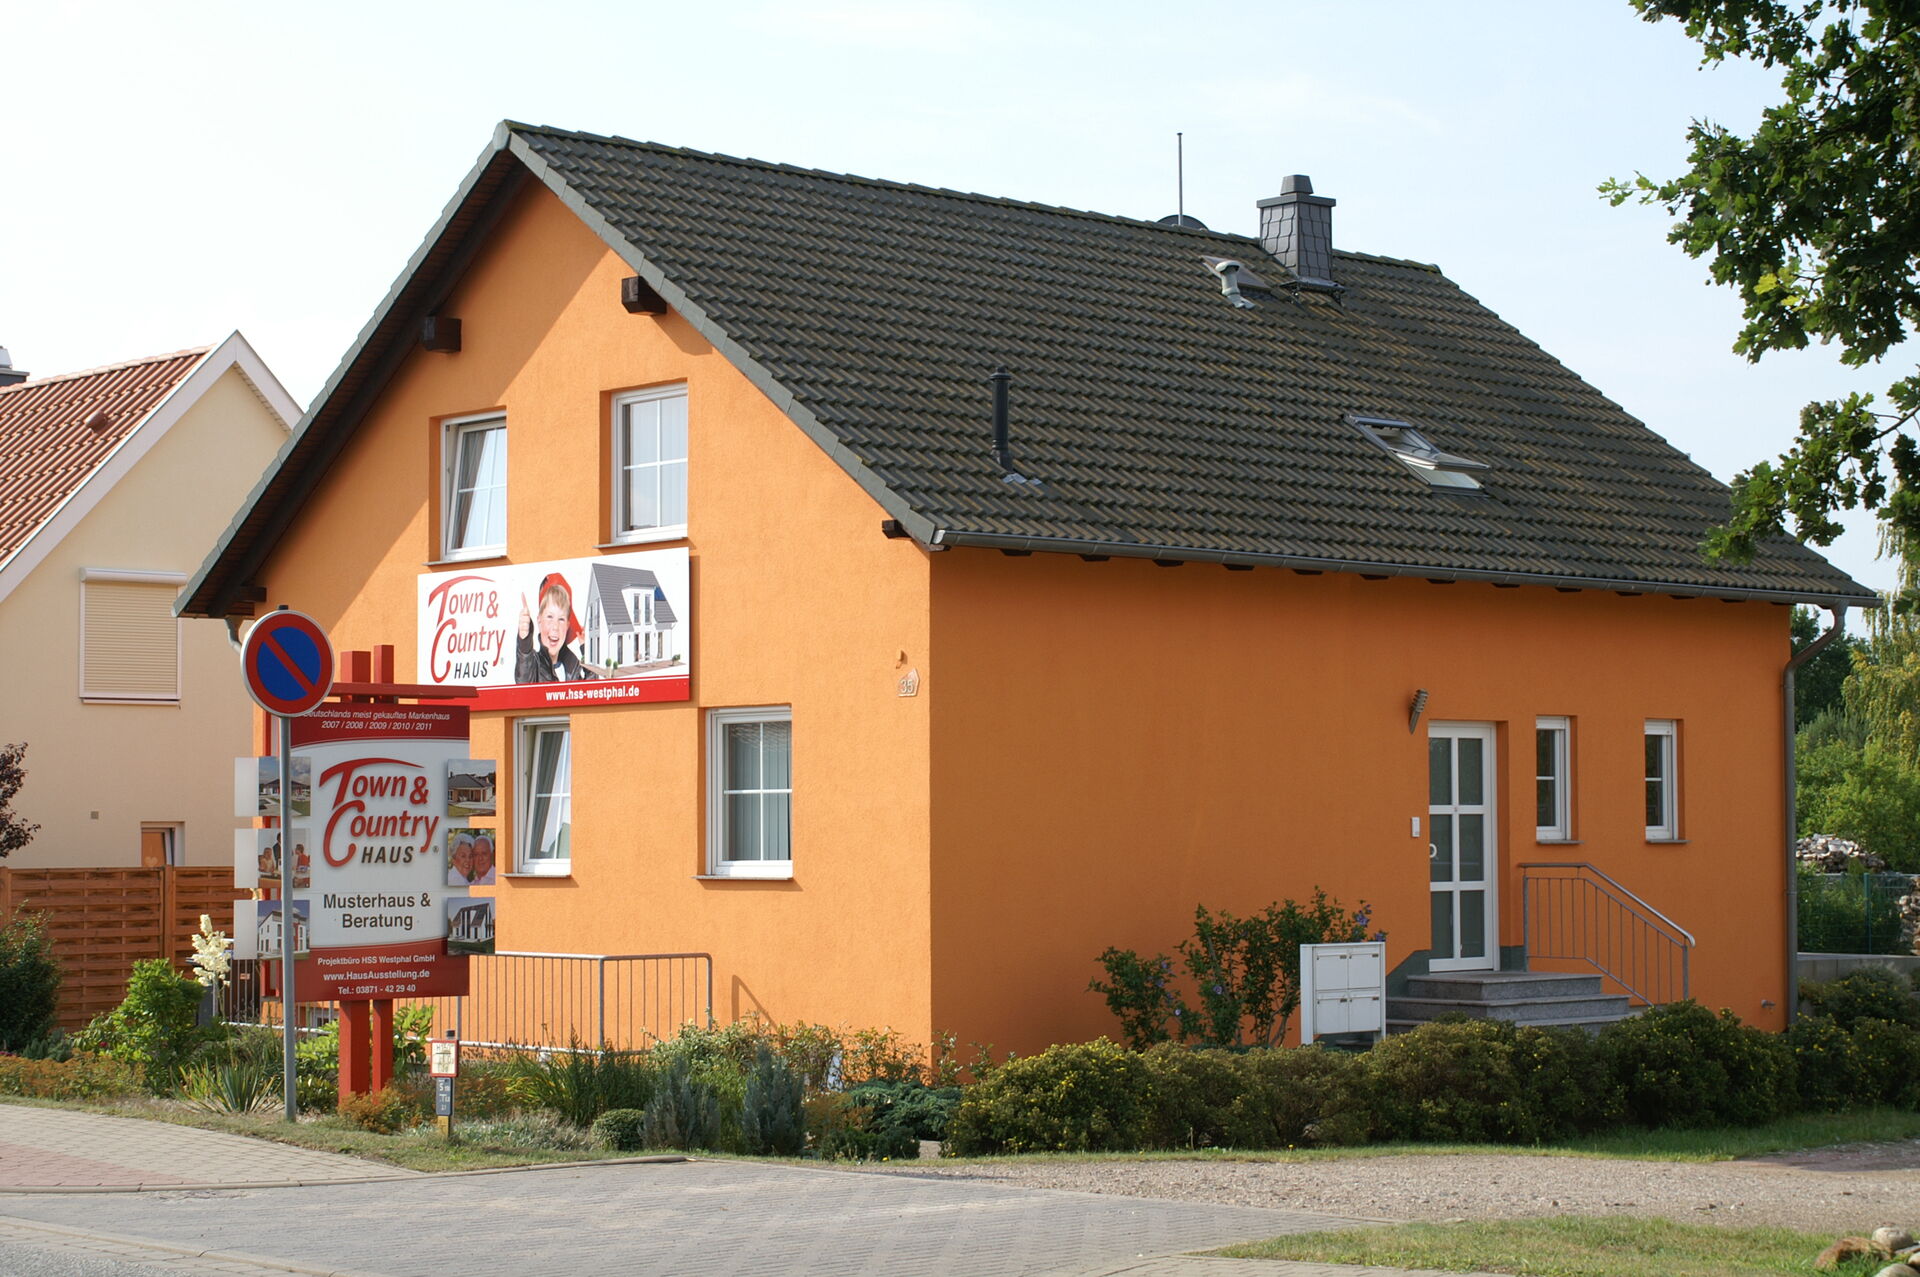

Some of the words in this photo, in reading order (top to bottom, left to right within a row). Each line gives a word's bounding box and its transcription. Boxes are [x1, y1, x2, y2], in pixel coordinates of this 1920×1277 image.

[428, 575, 496, 627] Town
[486, 591, 499, 619] &
[431, 618, 506, 684] Country
[454, 660, 488, 680] HAUS
[545, 685, 640, 702] www.hss-westphal.de
[899, 679, 915, 694] 35
[352, 711, 372, 719] meist
[373, 711, 407, 720] gekauftes
[408, 711, 450, 720] Markenhaus
[321, 720, 340, 729] 2007
[345, 721, 364, 729] 2008
[369, 721, 388, 730] 2009
[392, 722, 411, 730] 2010
[415, 722, 432, 731] 2011
[319, 757, 424, 810] Town
[409, 776, 429, 805] &
[323, 800, 440, 868] Country
[361, 846, 415, 864] HAUS
[323, 892, 415, 908] Musterhaus
[420, 892, 431, 907] &
[342, 912, 413, 931] Beratung
[317, 956, 360, 967] Projektbüro
[361, 956, 378, 964] HSS
[378, 955, 412, 965] Westphal
[412, 954, 435, 963] GmbH
[323, 969, 430, 980] www.HausAusstellung.de
[338, 986, 354, 995] Tel.:
[355, 985, 378, 994] 03871
[384, 984, 395, 993] 42
[395, 984, 406, 993] 29
[406, 984, 416, 992] 40
